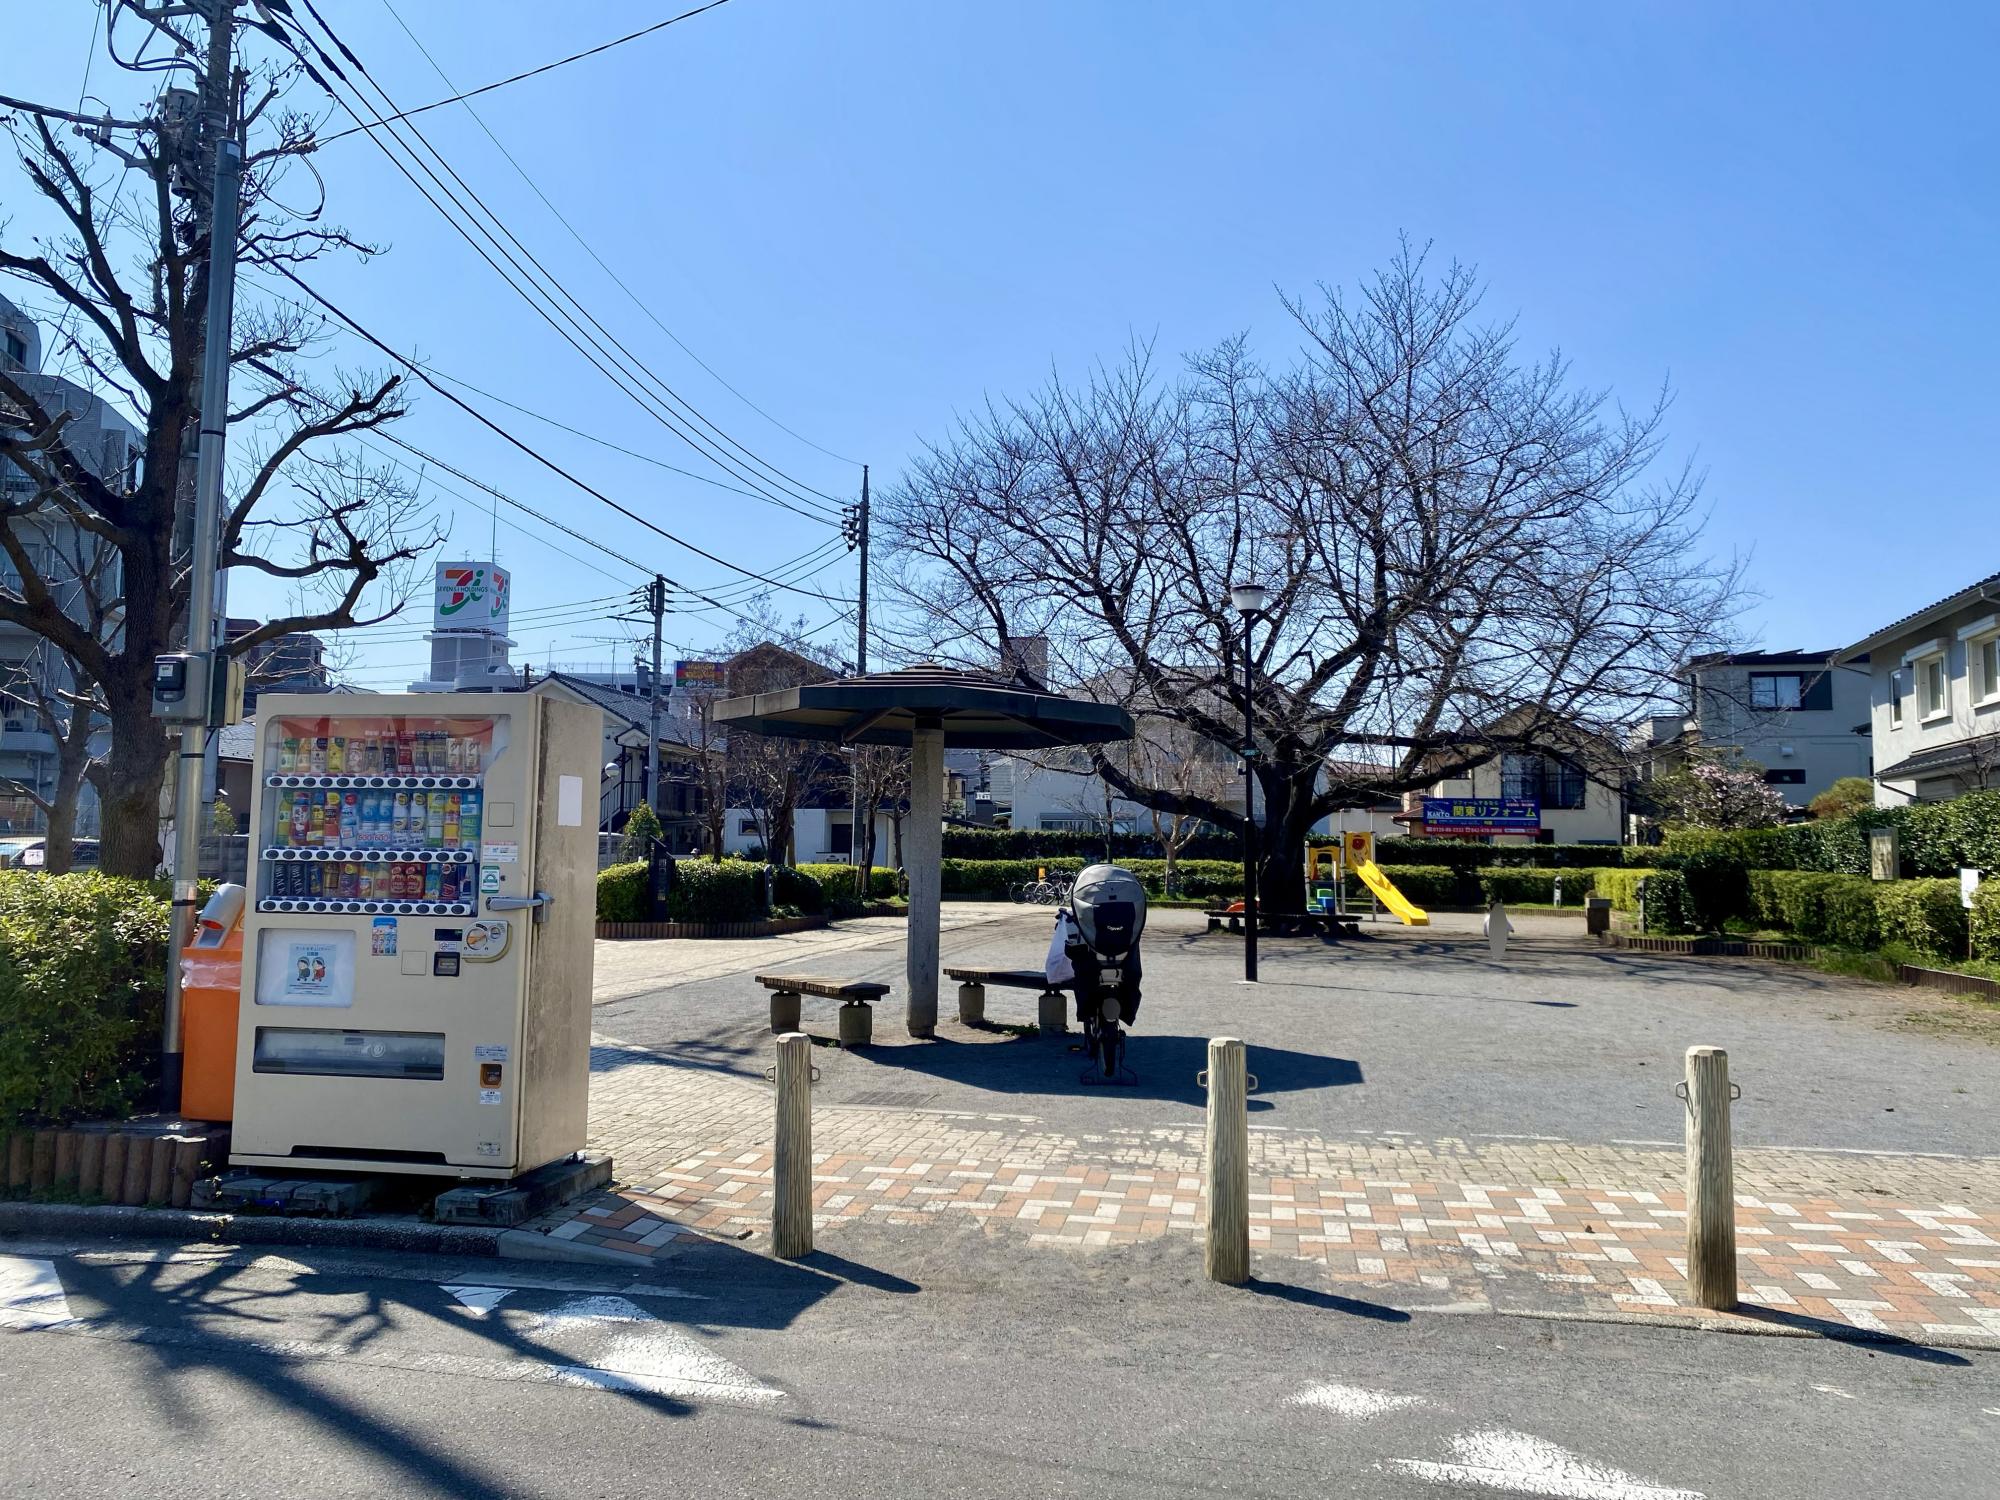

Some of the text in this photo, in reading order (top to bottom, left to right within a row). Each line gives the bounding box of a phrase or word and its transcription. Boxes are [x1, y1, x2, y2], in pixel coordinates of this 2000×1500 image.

[1427, 810, 1450, 818] KANTO
[1453, 805, 1536, 817] 関東リフォーム
